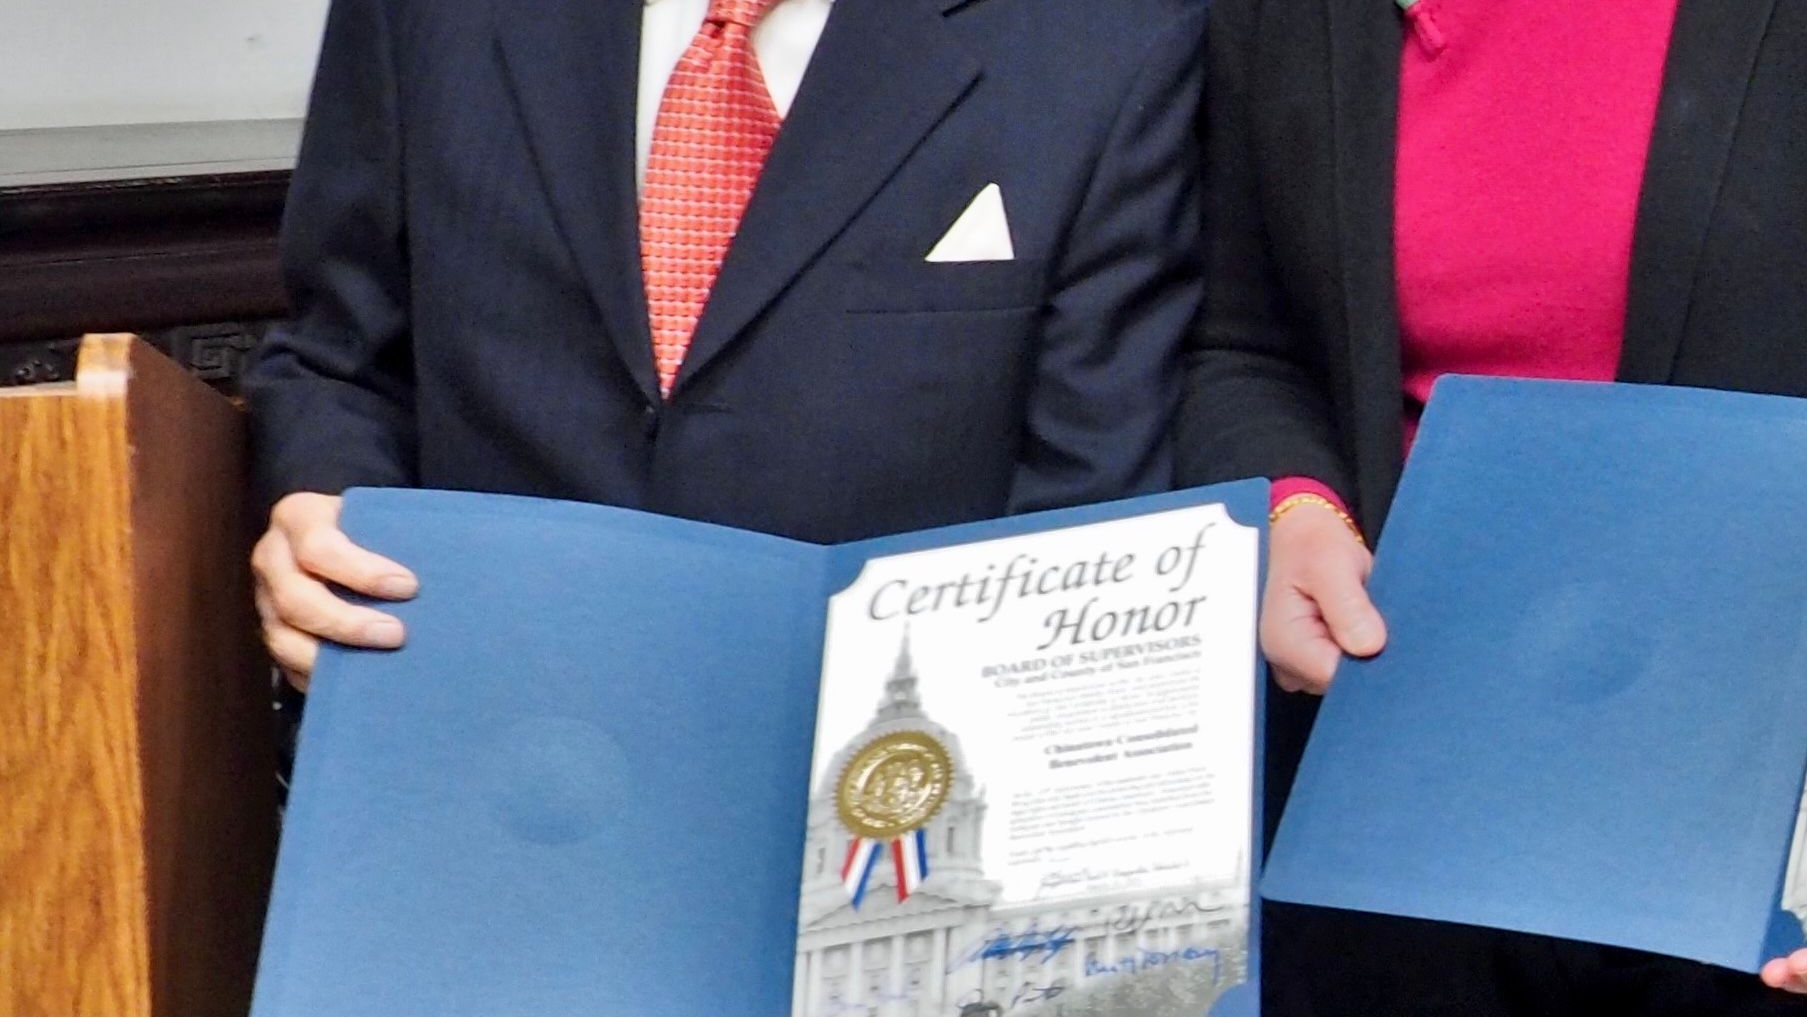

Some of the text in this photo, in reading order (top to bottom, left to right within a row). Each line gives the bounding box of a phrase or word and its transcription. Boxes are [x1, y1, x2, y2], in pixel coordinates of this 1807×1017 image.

[867, 521, 1217, 624] Certificate of
[1036, 595, 1207, 651] Honor
[981, 634, 1203, 679] BOARD OF SUPERVISORS
